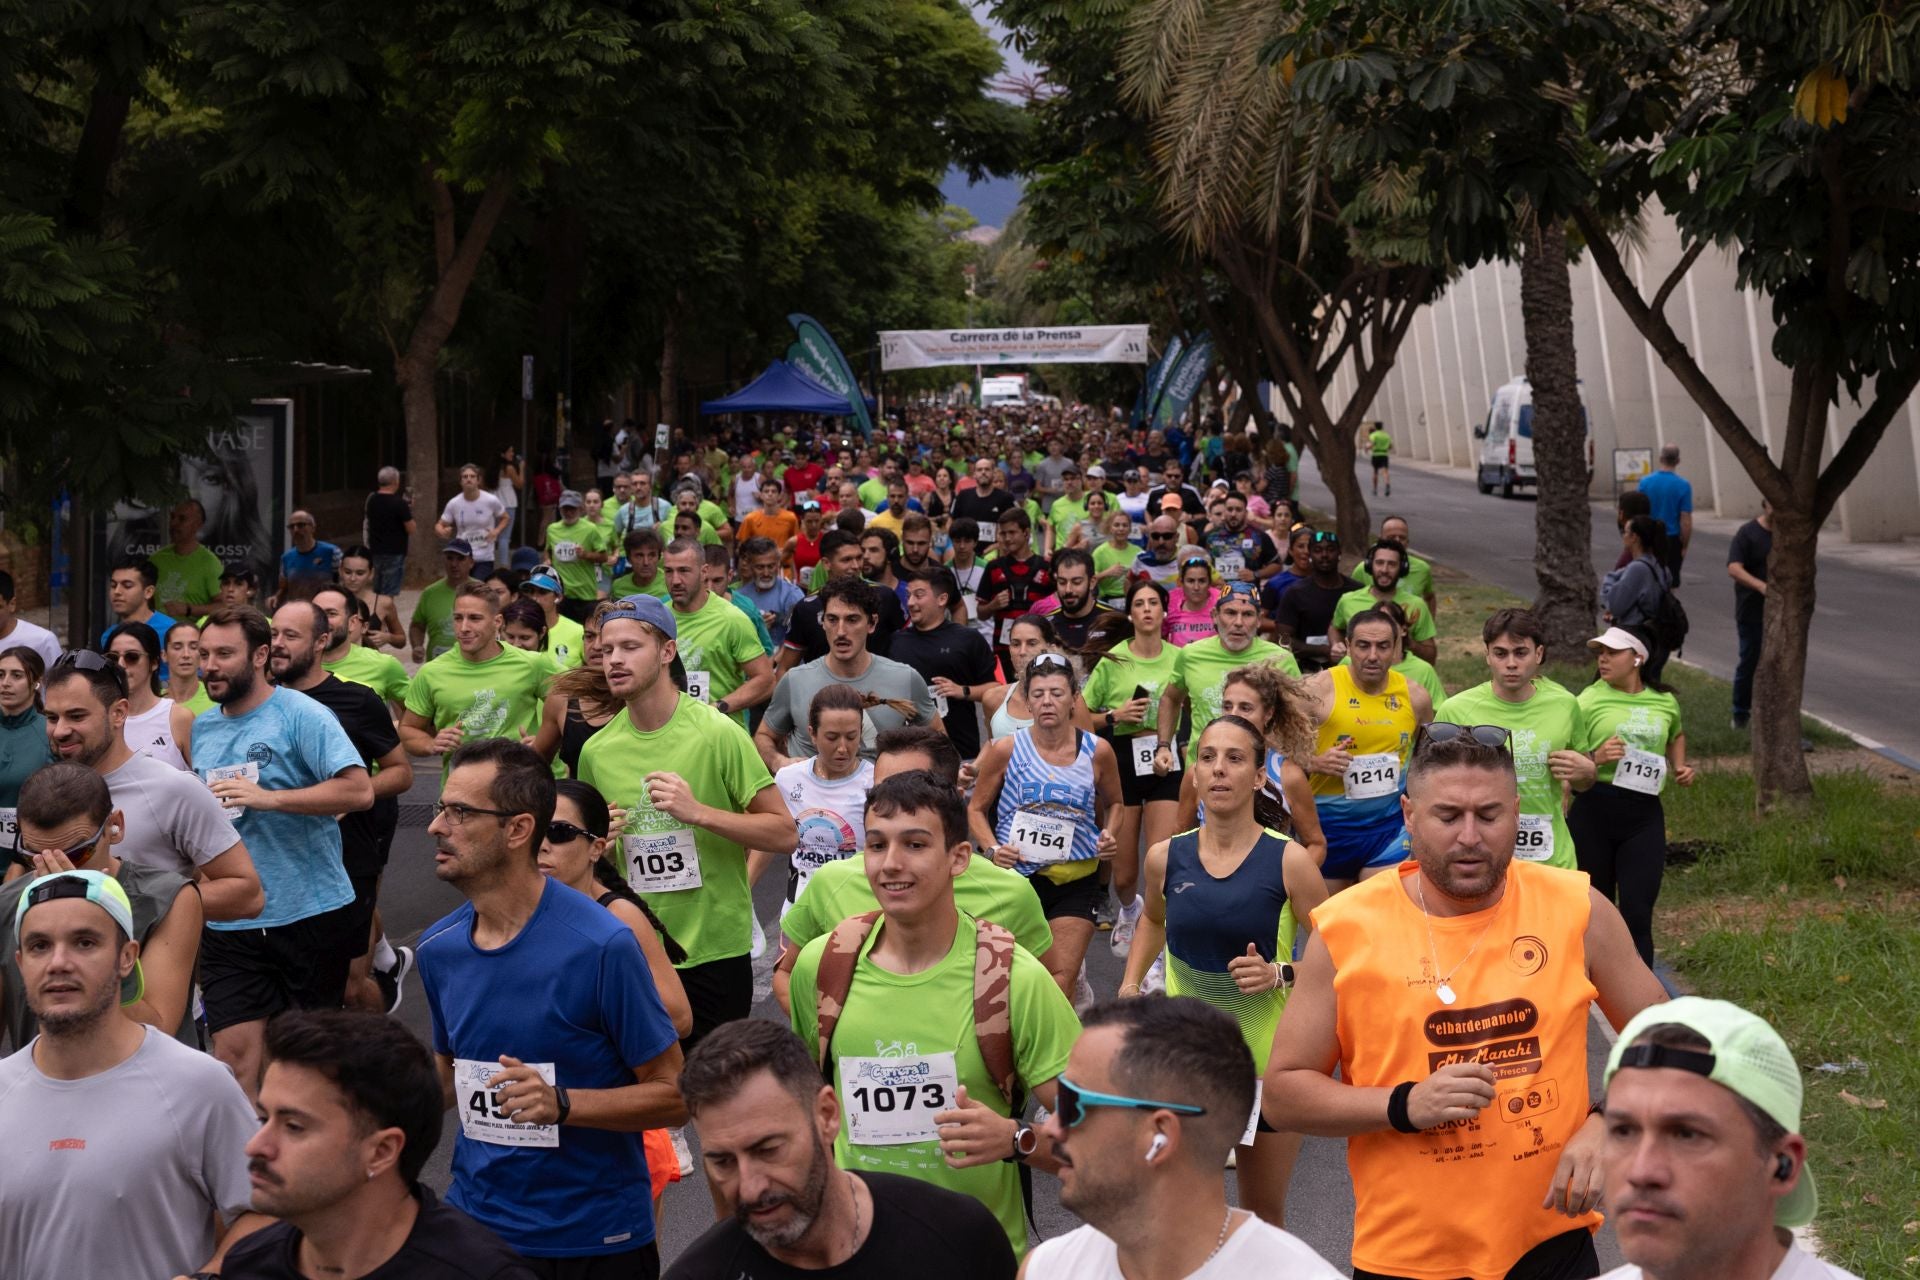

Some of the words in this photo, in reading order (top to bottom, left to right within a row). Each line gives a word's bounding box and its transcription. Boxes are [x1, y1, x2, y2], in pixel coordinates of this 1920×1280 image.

[950, 332, 999, 343] Carrera
[1002, 331, 1019, 341] de
[1022, 330, 1034, 340] la
[1037, 330, 1082, 341] Prensa
[1349, 767, 1395, 785] 1214
[1623, 761, 1660, 780] 1131
[1016, 828, 1065, 850] 1154
[632, 852, 685, 876] 103
[1468, 1042, 1532, 1064] Manchi
[871, 1063, 920, 1078] Carrera
[1500, 1065, 1528, 1079] Fresca
[852, 1083, 946, 1112] 1073
